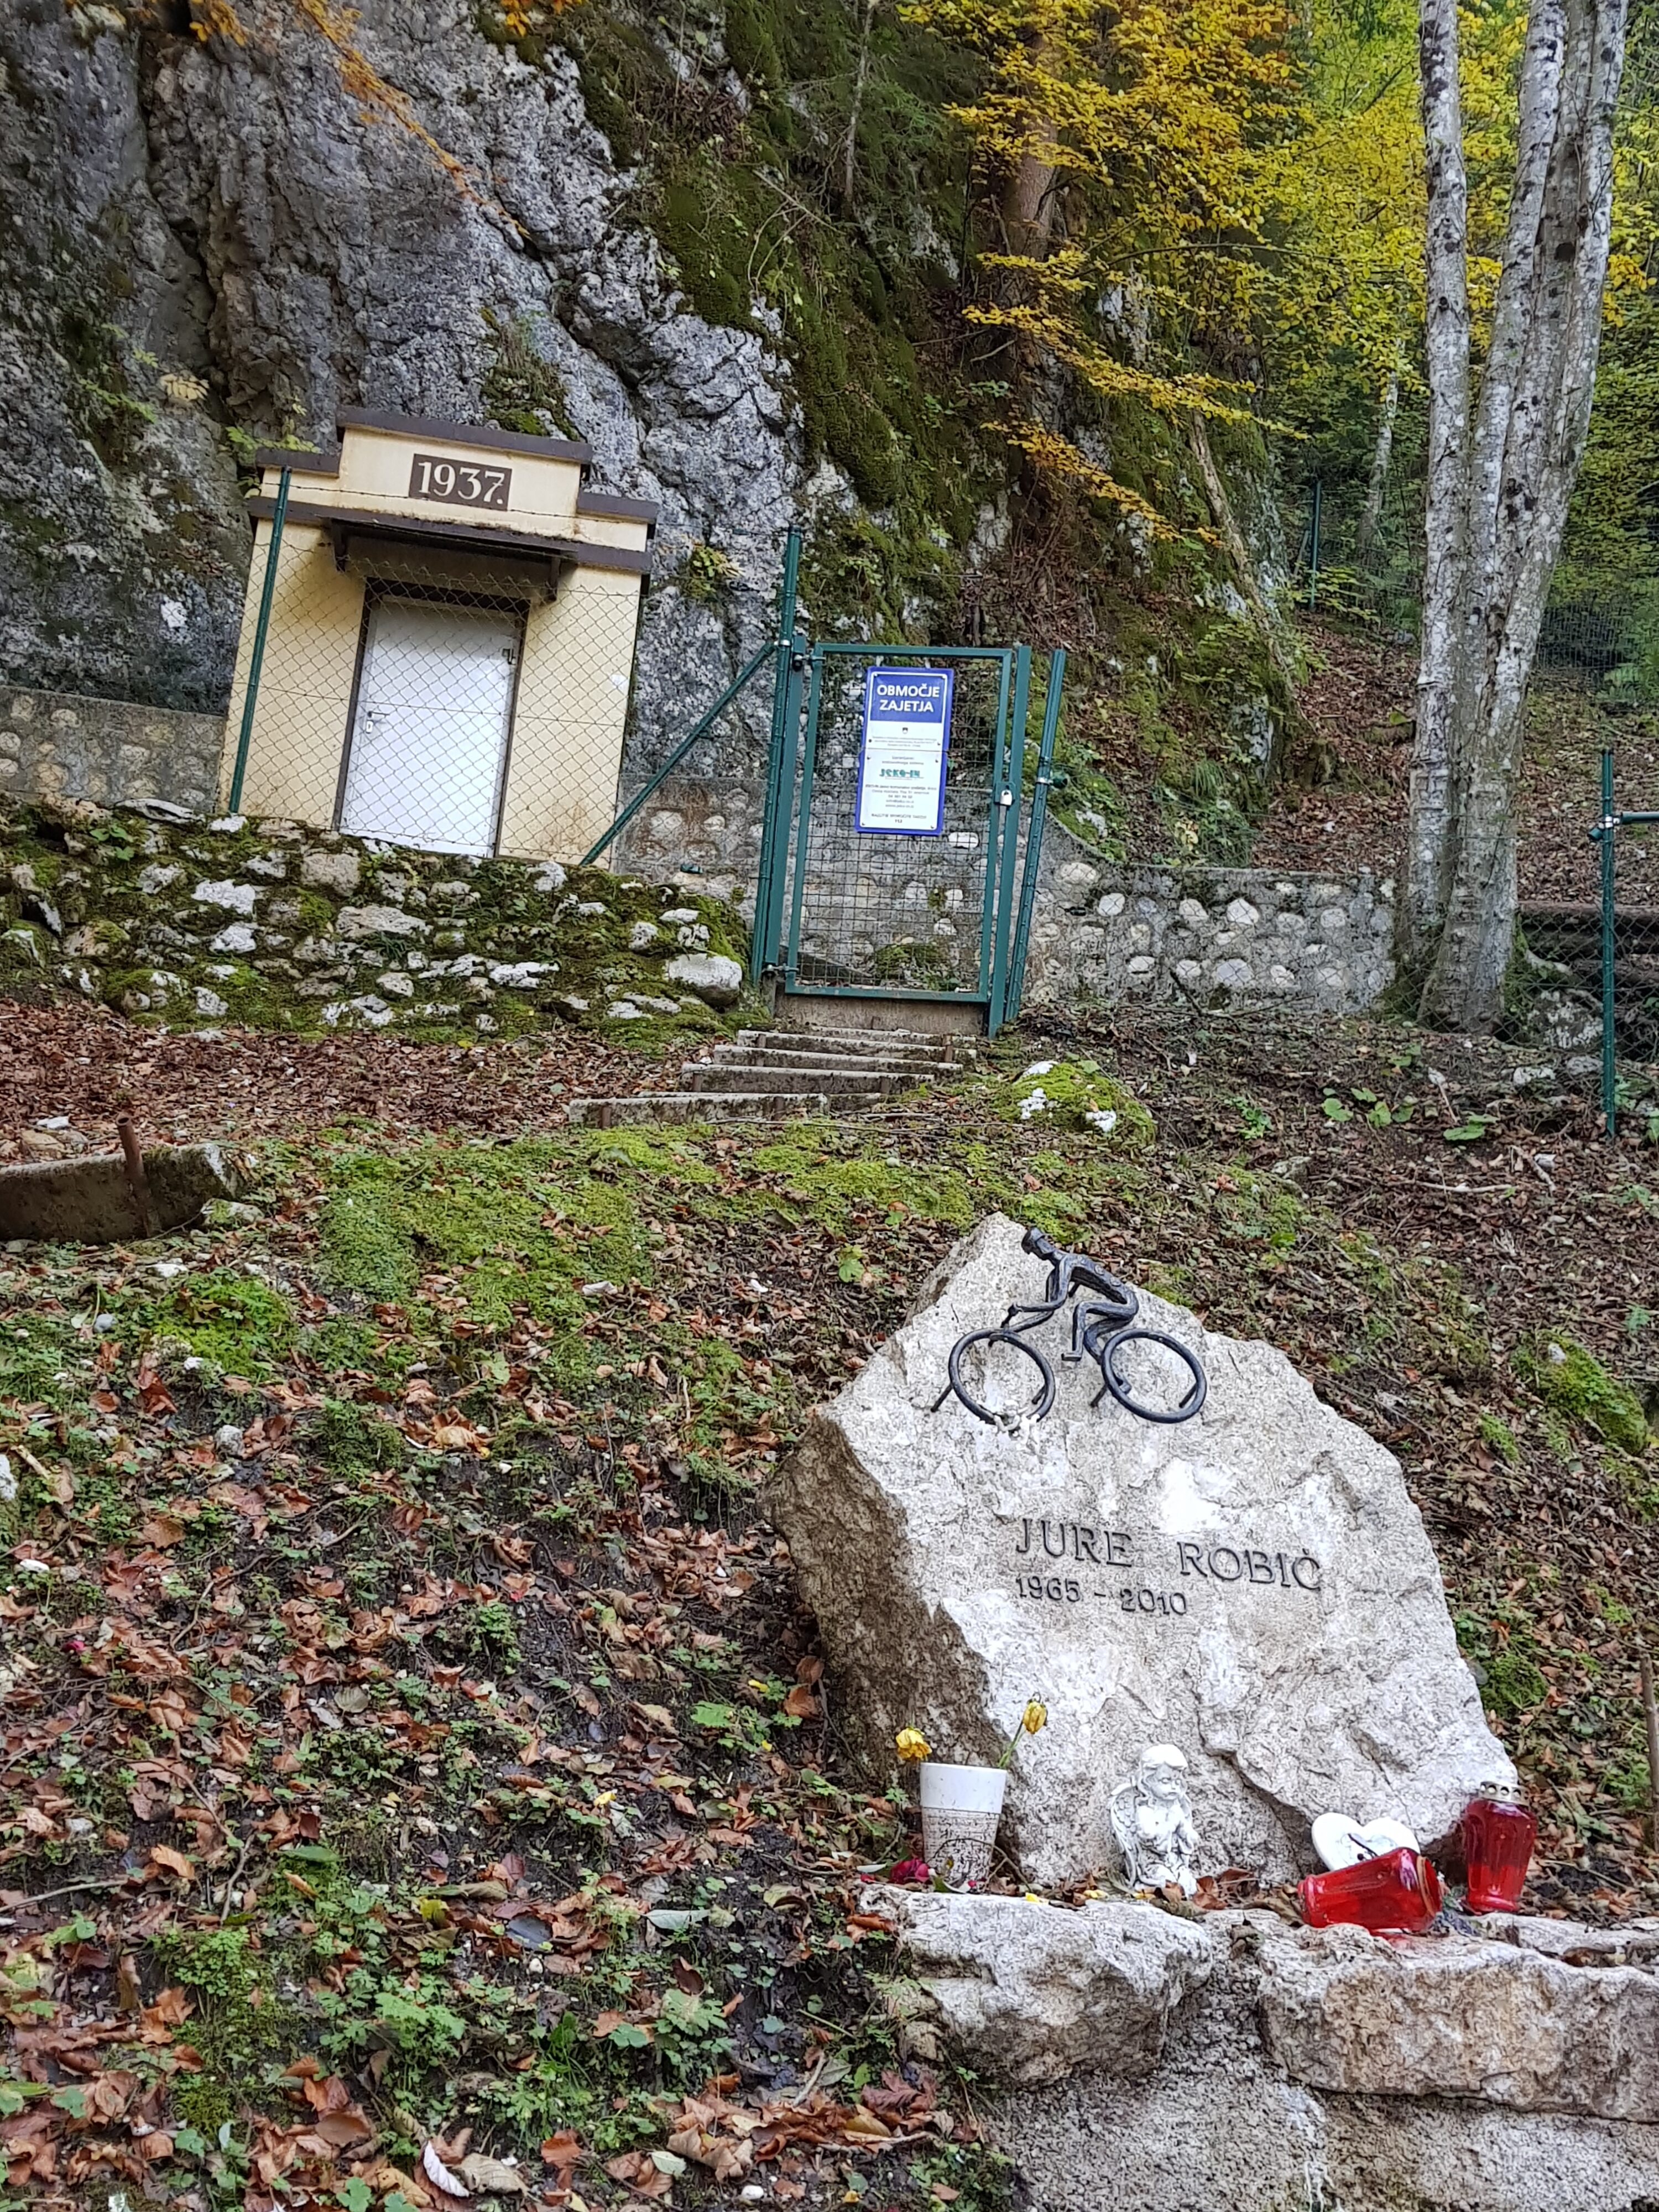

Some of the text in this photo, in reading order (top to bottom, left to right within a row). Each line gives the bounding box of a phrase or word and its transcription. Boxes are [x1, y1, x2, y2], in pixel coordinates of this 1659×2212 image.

[418, 461, 505, 504] 1937.
[877, 683, 940, 698] OBMOČJE
[879, 700, 934, 712] ZAJETJA
[1016, 1518, 1133, 1567] JURE
[1016, 1575, 1081, 1602] 1965
[1120, 1588, 1188, 1615] 2010
